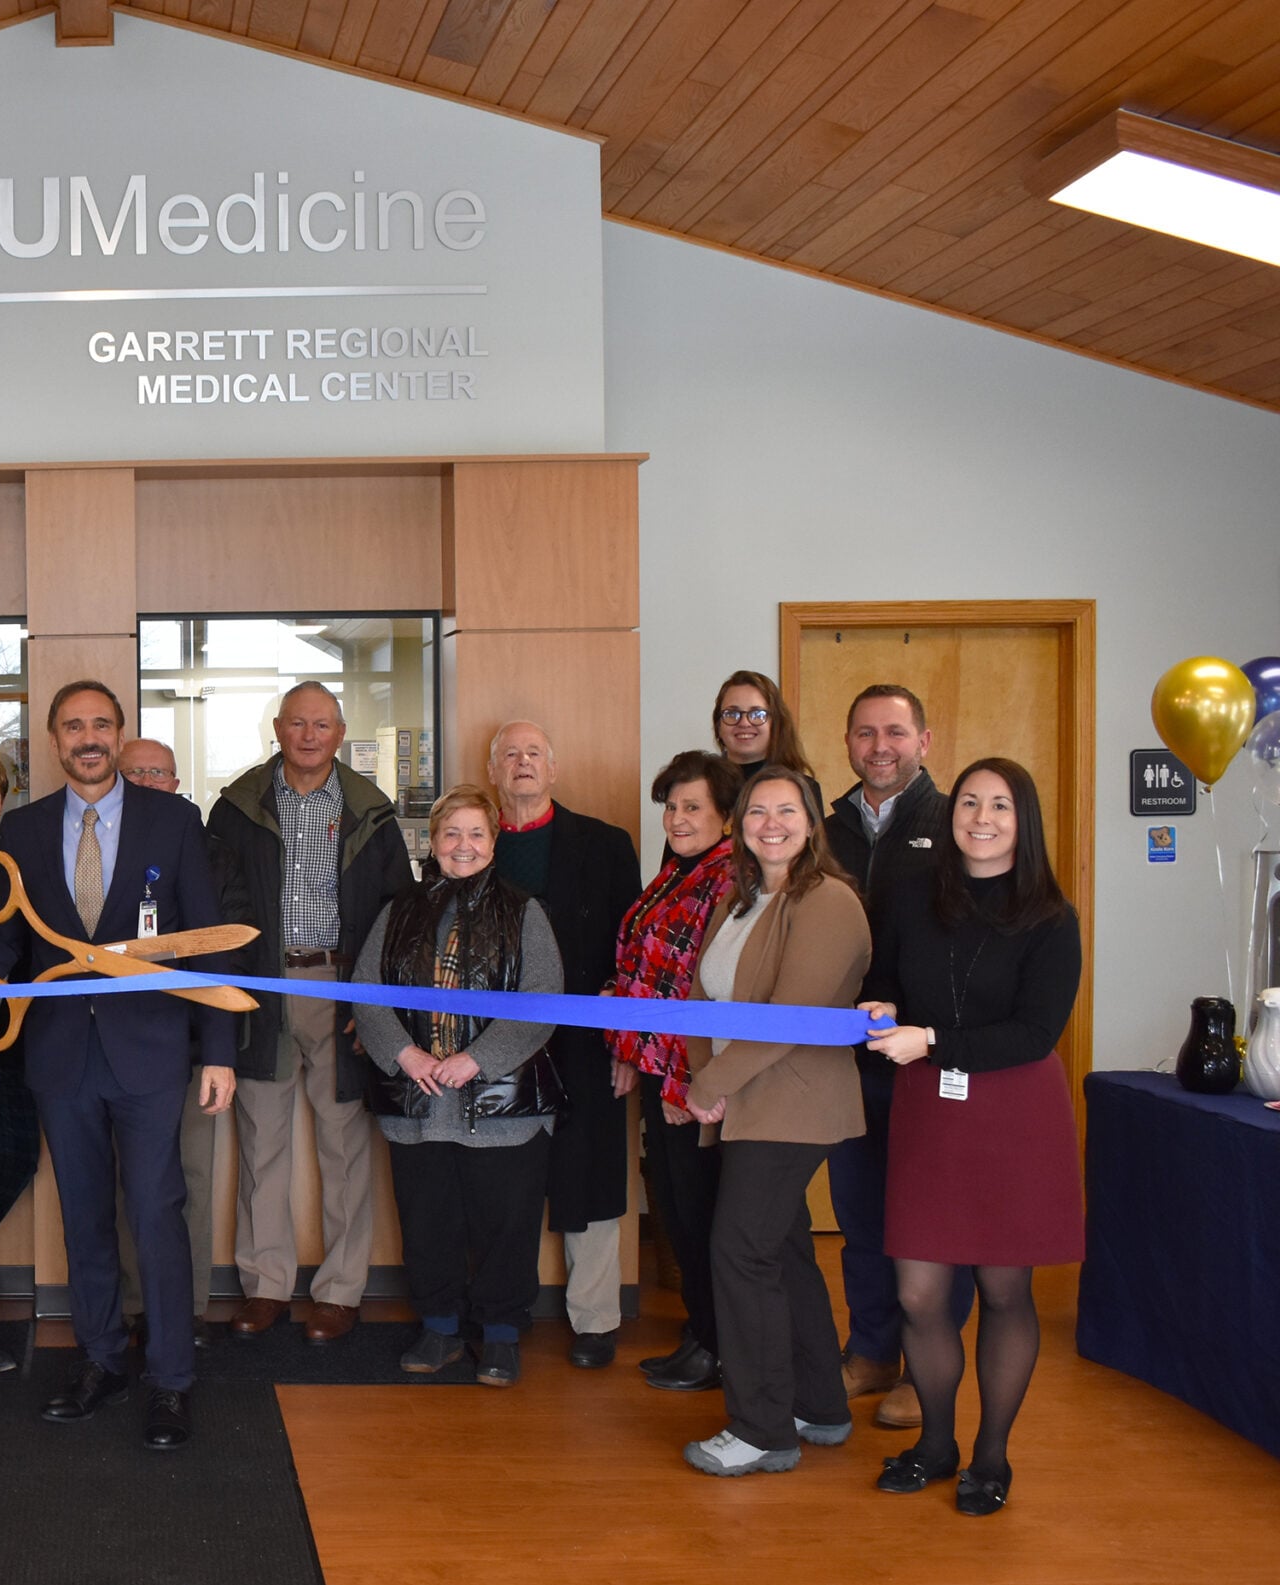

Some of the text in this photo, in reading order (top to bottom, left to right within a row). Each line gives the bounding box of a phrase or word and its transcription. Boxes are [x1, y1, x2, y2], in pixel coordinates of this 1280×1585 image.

[88, 327, 489, 363] GARRETT REGIONAL
[138, 370, 479, 404] MEDICAL CENTER
[1141, 797, 1186, 806] RESTROOM
